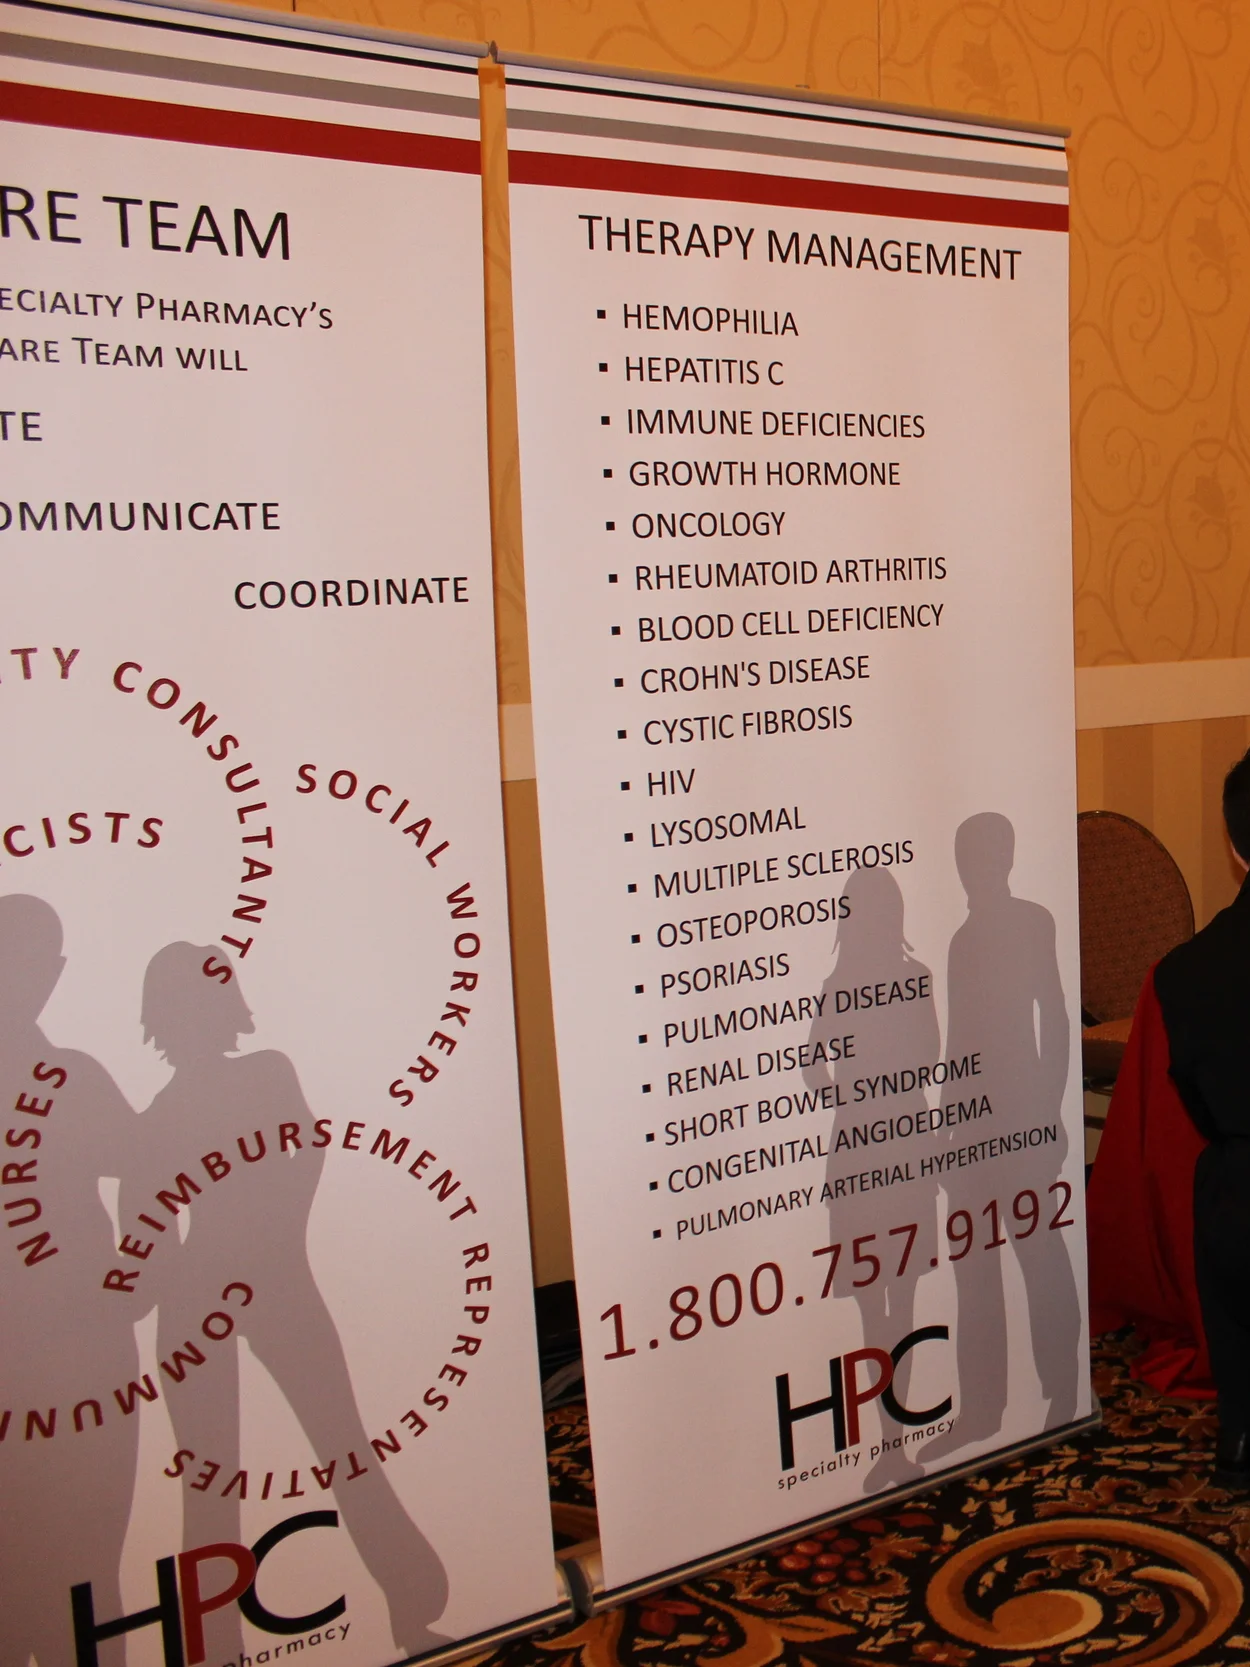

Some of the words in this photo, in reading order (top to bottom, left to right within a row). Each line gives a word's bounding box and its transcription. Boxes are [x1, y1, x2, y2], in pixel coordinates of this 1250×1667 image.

[102, 195, 291, 260] TEAM
[578, 214, 755, 261] THERAPY
[767, 229, 1022, 281] MANAGEMENT
[622, 303, 800, 337] HEMOPHILIA
[71, 337, 163, 368] TEAM
[174, 348, 249, 373] WILL
[624, 356, 760, 385] HEPATITIS
[766, 360, 785, 386] C
[626, 408, 753, 436] IMMUNE
[761, 410, 926, 439] DEFICIENCIES
[628, 460, 757, 487] GROWTH
[766, 461, 901, 487] HORMONE
[631, 510, 786, 539] ONCOLOGY
[233, 575, 470, 610] COORDINATE
[635, 560, 818, 591] RHEUMATOID
[826, 556, 948, 583] ARTHRITIS
[637, 613, 735, 643] BLOOD
[741, 609, 800, 637] CELL
[807, 603, 945, 634] DEFICIENCY
[640, 661, 762, 694] CROHN'S
[768, 655, 870, 686] DISEASE
[642, 714, 735, 746] CYSTIC
[742, 704, 854, 738] FIBROSIS
[647, 768, 696, 797] HIV
[113, 661, 273, 984] CONSULTANTS
[650, 805, 807, 848] LYSOSOMAL
[653, 857, 779, 898] MULTIPLE
[786, 840, 915, 879] SCLEROSIS
[296, 763, 451, 869] SOCIAL
[388, 882, 481, 1107] WORKERS
[656, 895, 852, 948] OSTEOPOROSIS
[659, 953, 791, 998] PSORIASIS
[663, 993, 827, 1048] PULMONARY
[834, 975, 931, 1015] DISEASE
[666, 1057, 750, 1097] RENAL
[756, 1035, 856, 1078] DISEASE
[664, 1104, 750, 1147] SHORT
[757, 1087, 848, 1125] BOWEL
[853, 1053, 983, 1103] SYNDROME
[1, 1061, 68, 1268] NURSES
[667, 1139, 829, 1194] CONGENITAL
[834, 1094, 993, 1153] ANGIOEDEMA
[103, 1118, 478, 1294] REIMBURSEMENT
[676, 1187, 814, 1241] PULMONARY
[820, 1161, 916, 1203] ARTERIAL
[920, 1124, 1058, 1178] HYPERTENSION
[599, 1180, 1075, 1361] 1.800.757.9192
[163, 1242, 493, 1501] REPRESENTATIVES
[775, 1324, 953, 1472] HPC
[777, 1449, 861, 1490] specialty
[869, 1417, 956, 1461] pharmacy
[70, 1509, 347, 1667] HPC
